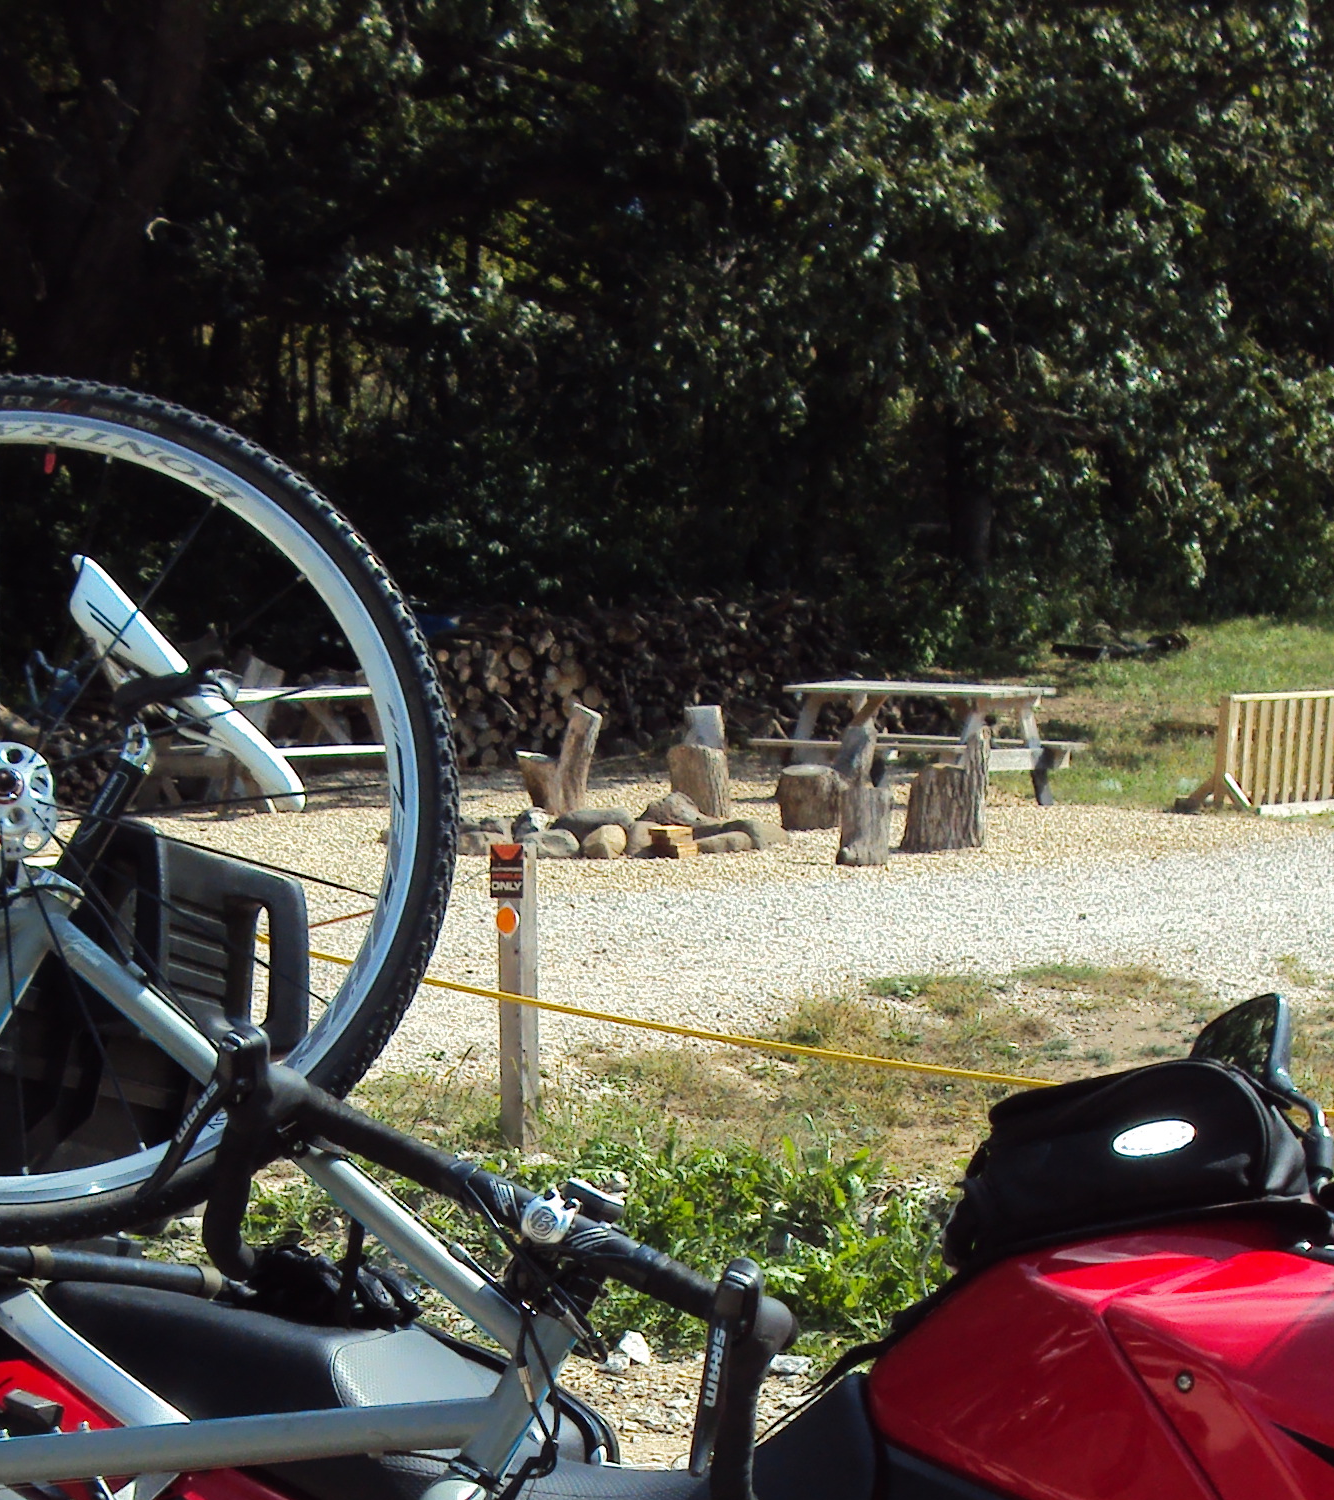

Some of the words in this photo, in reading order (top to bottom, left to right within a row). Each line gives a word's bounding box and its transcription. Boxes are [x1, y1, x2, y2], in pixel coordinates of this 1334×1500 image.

[491, 881, 523, 891] ONLY
[175, 1079, 219, 1143] SRAM
[703, 1327, 727, 1408] SRAM
